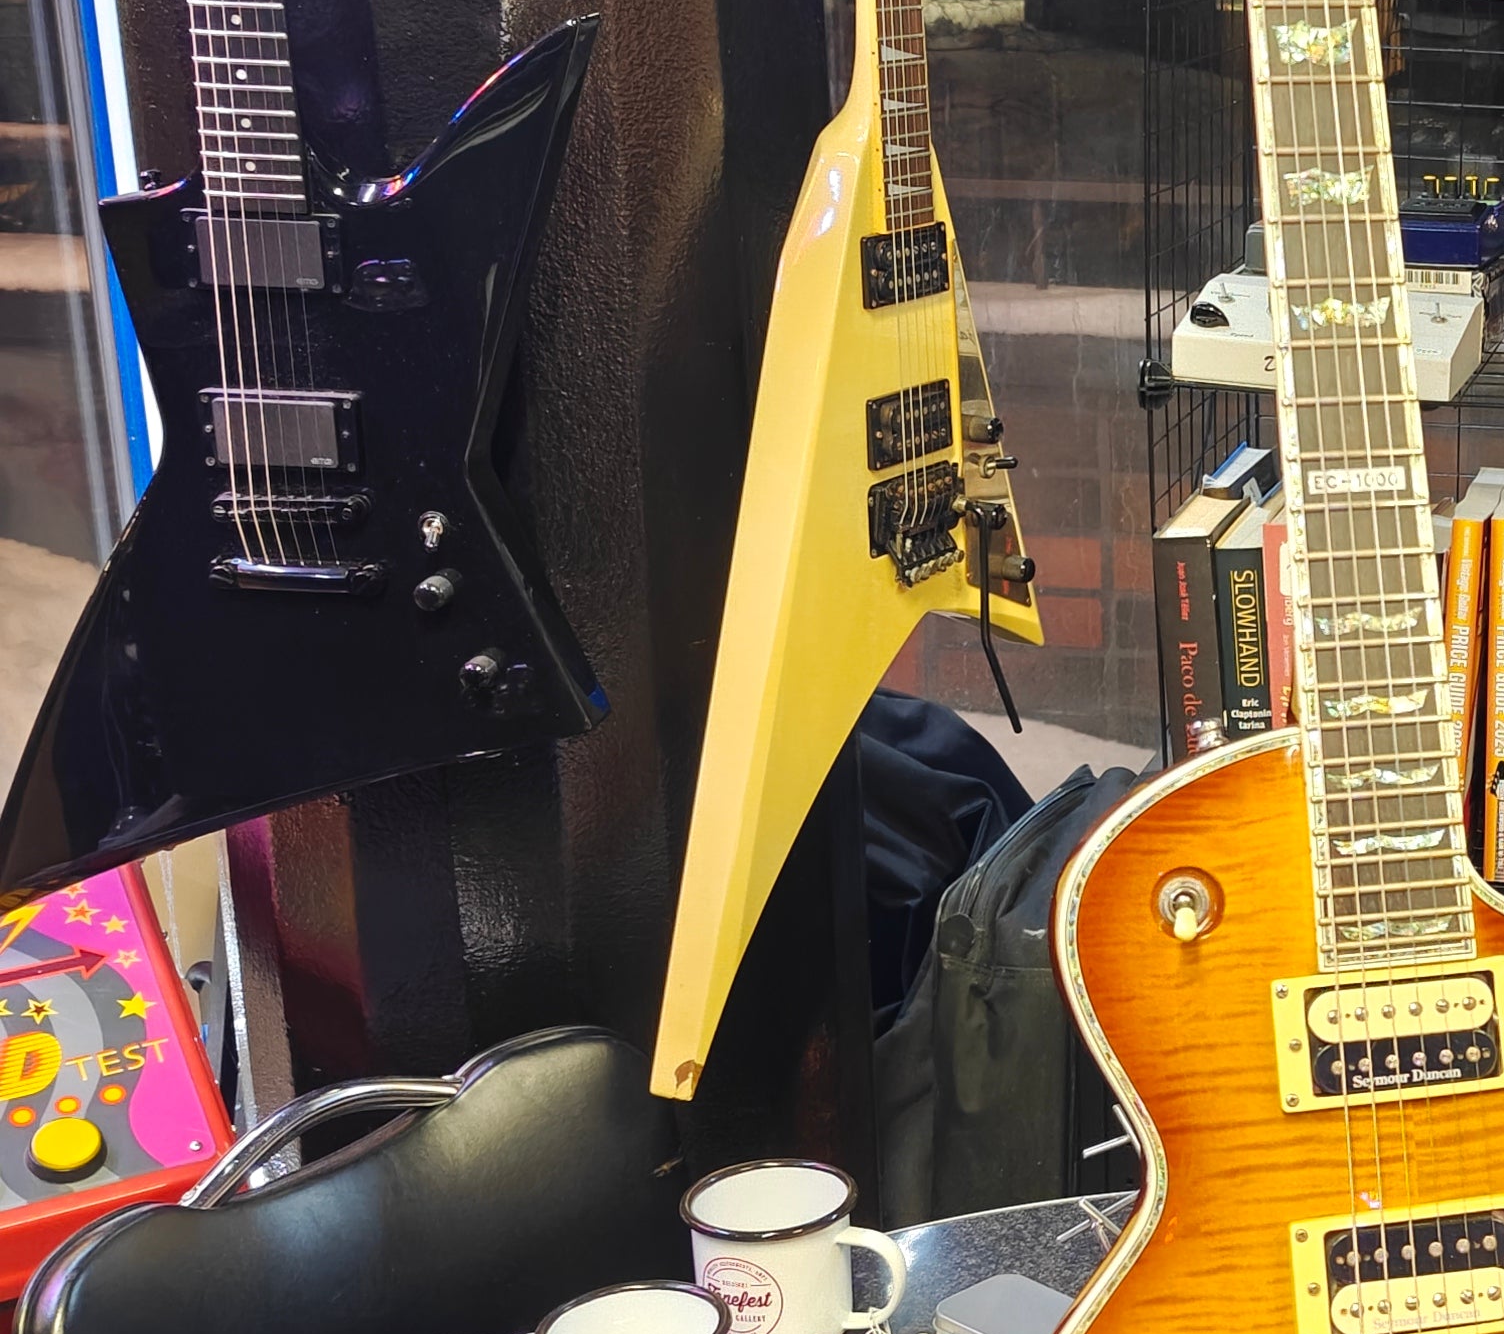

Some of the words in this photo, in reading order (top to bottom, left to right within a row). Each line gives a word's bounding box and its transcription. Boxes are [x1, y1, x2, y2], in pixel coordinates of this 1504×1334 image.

[1314, 472, 1398, 490] EC-1000
[1234, 571, 1261, 688] SLOWHAND
[1451, 625, 1470, 668] PRICE
[1179, 642, 1198, 688] Paco
[1183, 693, 1203, 717] de
[1242, 699, 1259, 707] Eric
[1450, 672, 1467, 715] GUIDE
[64, 1038, 169, 1082] TEST
[1352, 1071, 1408, 1089] Seymour
[1411, 1066, 1462, 1083] Duncan
[708, 1283, 773, 1313] Tnefest
[1432, 1307, 1481, 1324] Duncan
